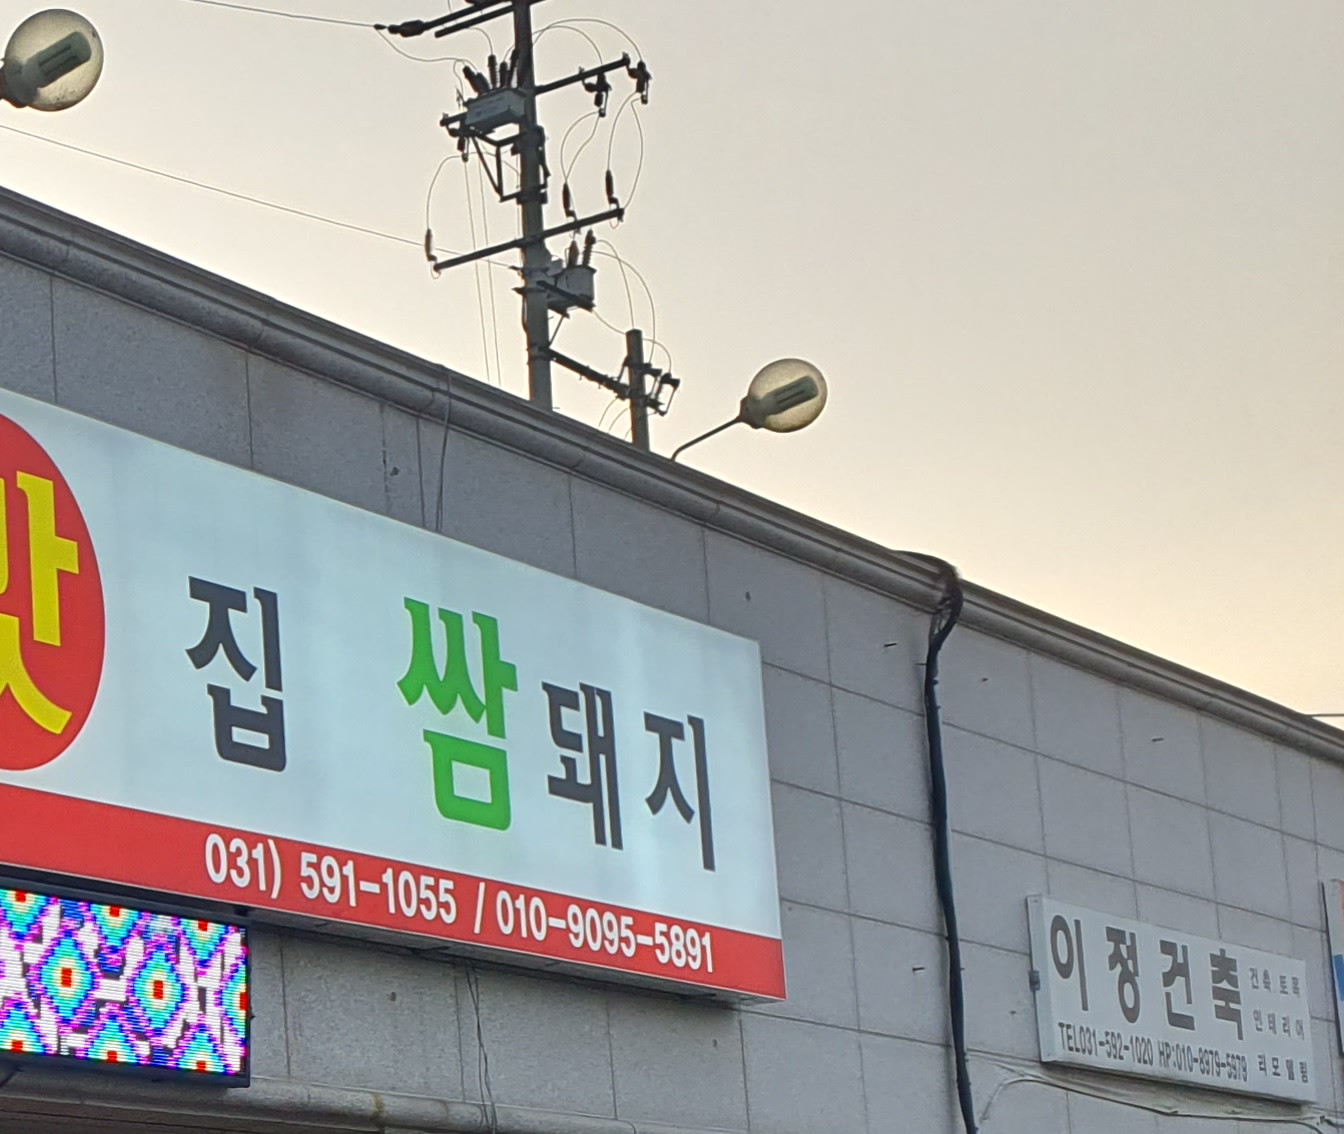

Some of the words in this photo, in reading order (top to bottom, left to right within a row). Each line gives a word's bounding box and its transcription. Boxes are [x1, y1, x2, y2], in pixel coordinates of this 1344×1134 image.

[186, 577, 287, 772] 집
[397, 596, 715, 872] 쌈돼지
[205, 833, 282, 899] 031)
[301, 851, 456, 924] 591-1055
[495, 889, 714, 973] 010-9095-5891
[1050, 915, 1244, 1040] 이정건축
